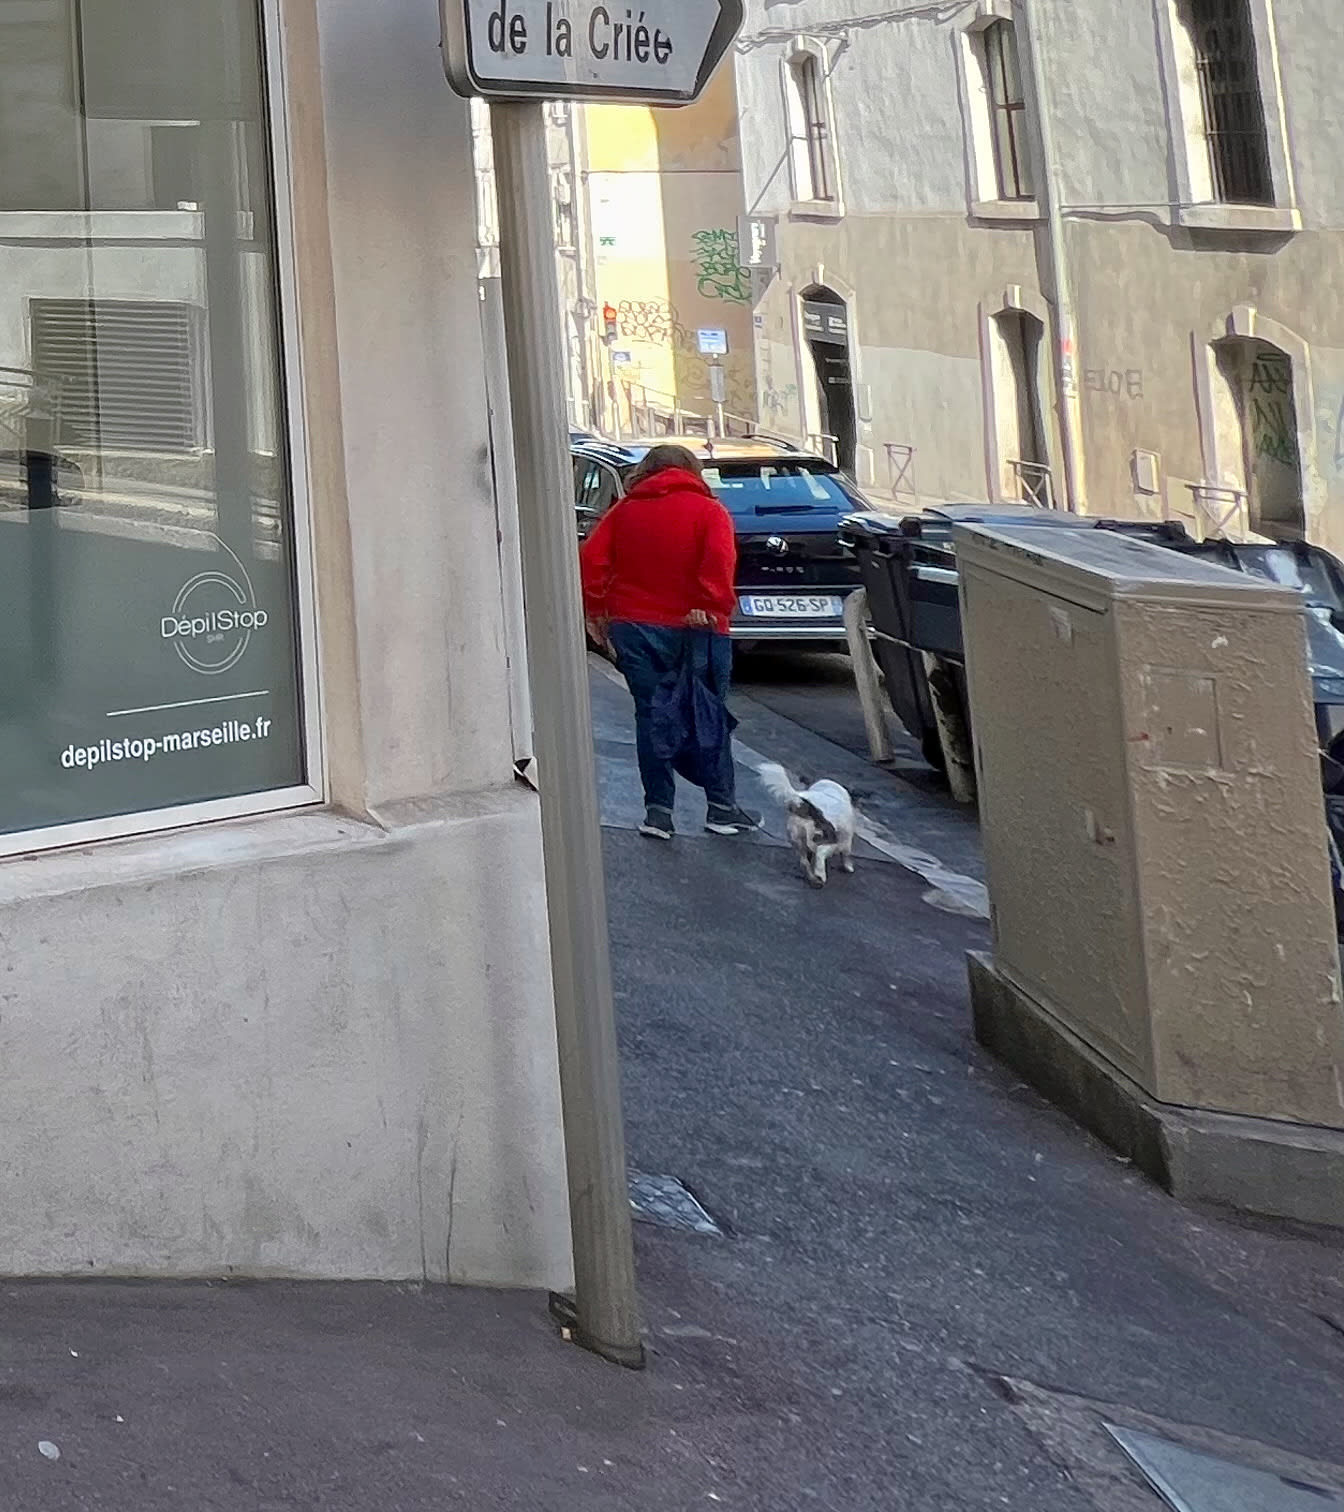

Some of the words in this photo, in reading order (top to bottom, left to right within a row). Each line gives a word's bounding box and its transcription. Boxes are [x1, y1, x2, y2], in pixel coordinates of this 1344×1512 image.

[546, 1, 573, 57] la
[588, 5, 673, 65] Criée
[160, 609, 268, 639] DépilStop
[60, 716, 272, 770] depilstop-marseille.fr
